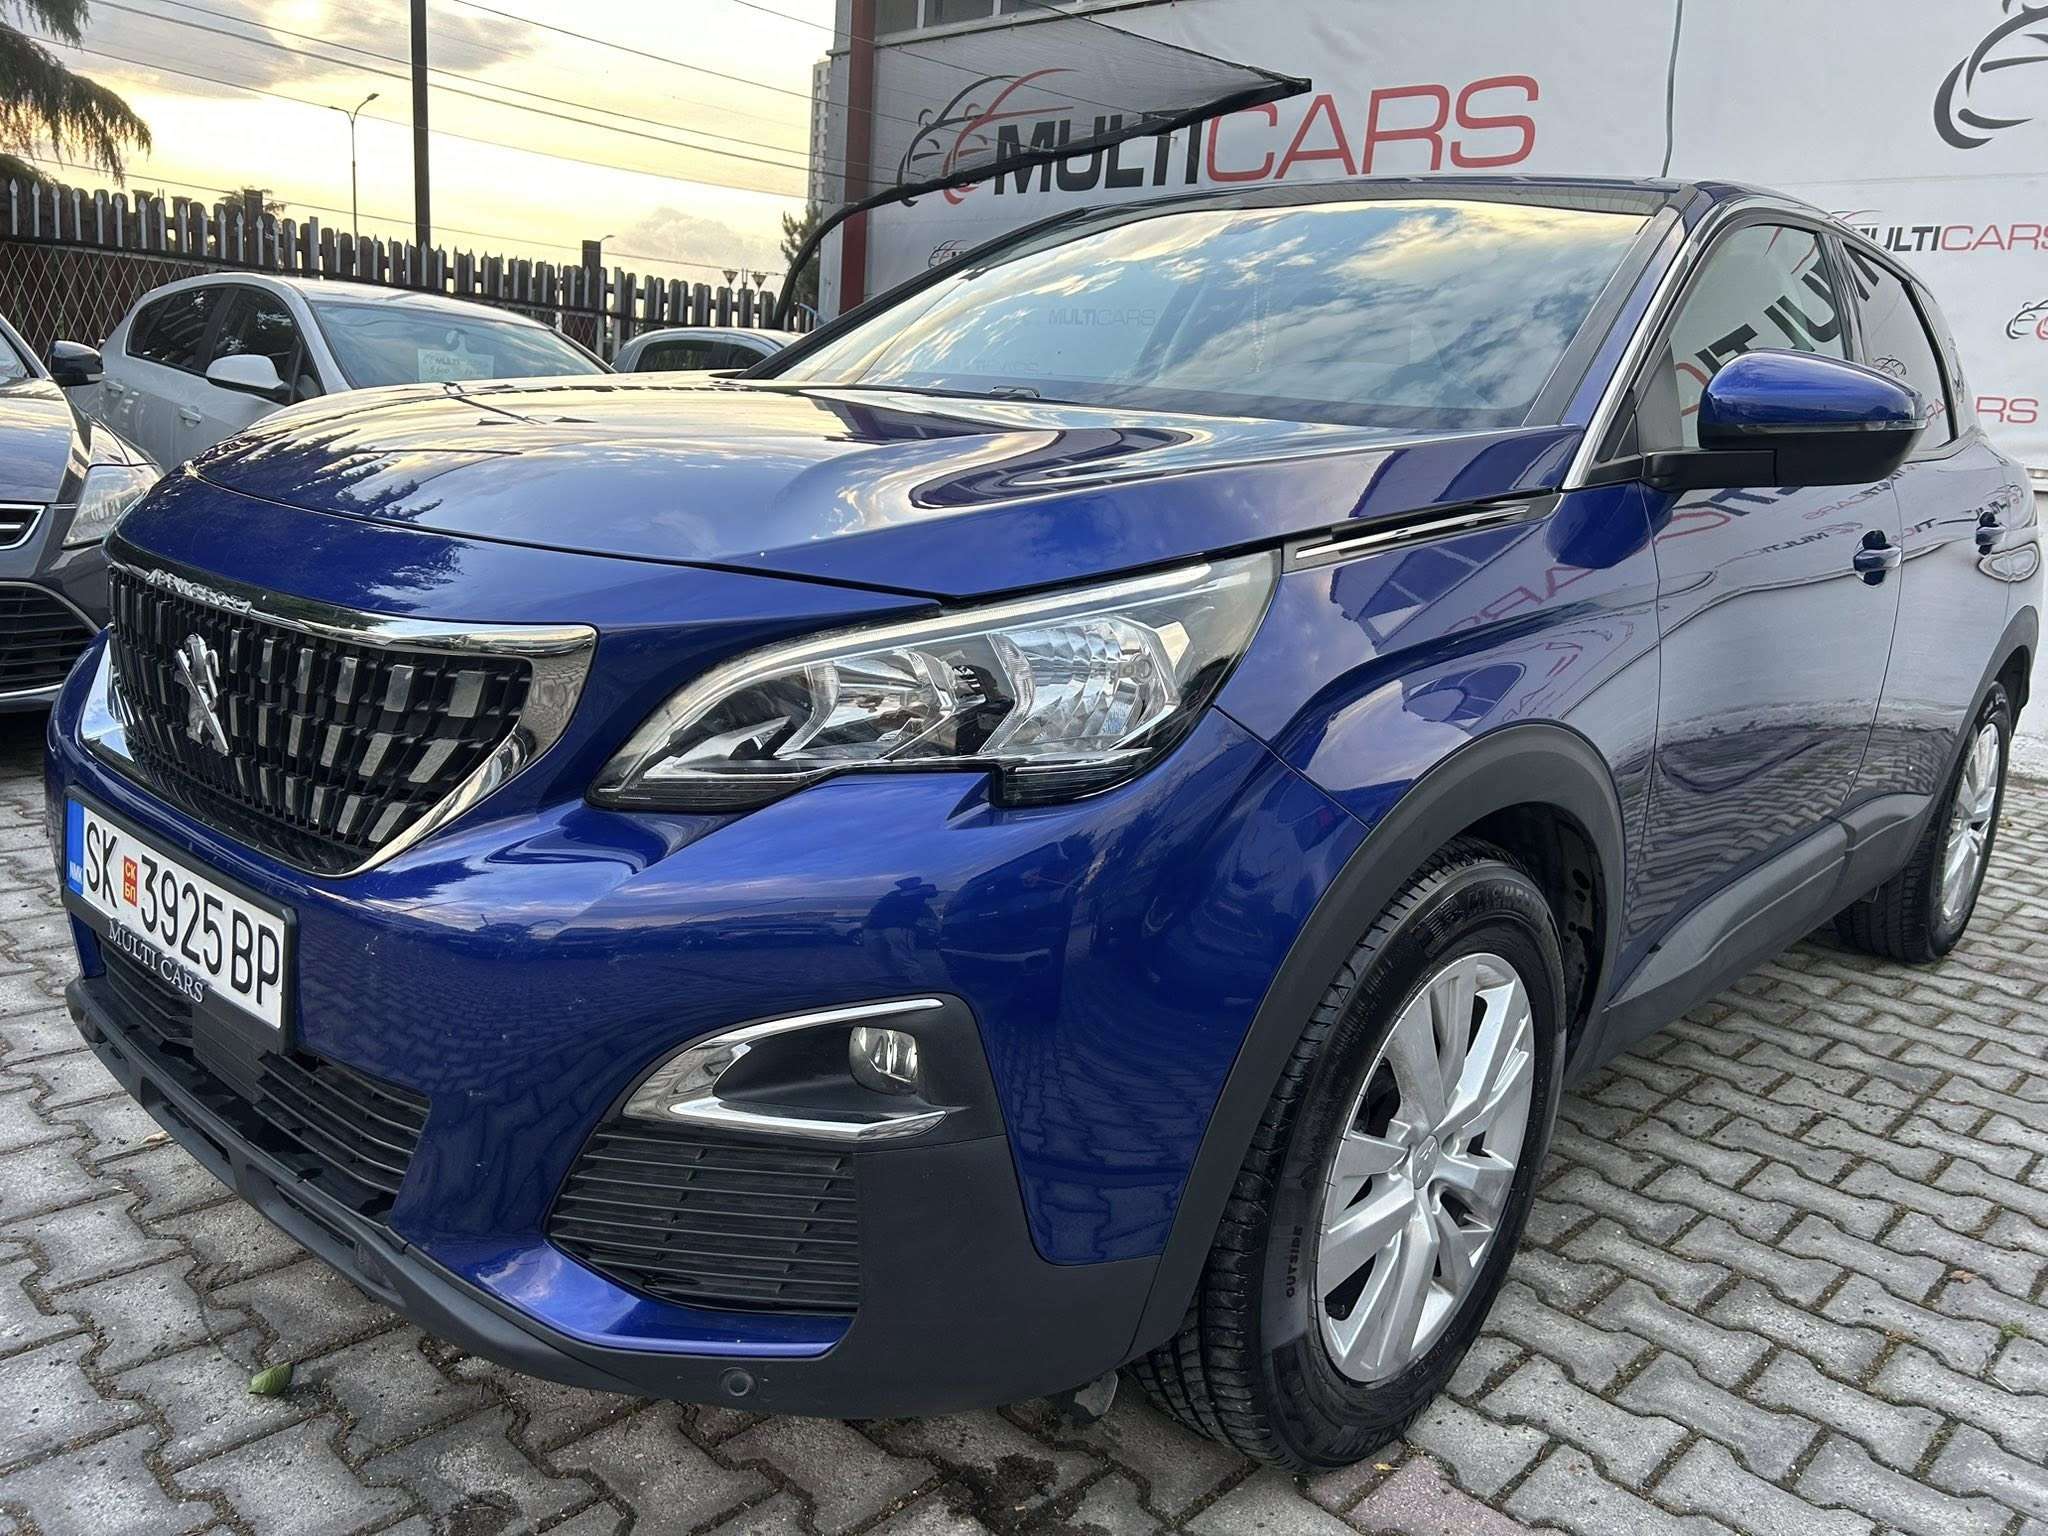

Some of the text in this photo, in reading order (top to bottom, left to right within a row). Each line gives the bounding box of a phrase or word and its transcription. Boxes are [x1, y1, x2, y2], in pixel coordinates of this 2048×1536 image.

[993, 75, 1539, 196] MULTICARS
[86, 821, 118, 909] SK
[109, 919, 205, 1004] MULTI CARS
[1285, 1224, 1304, 1299] OUTSIDE
